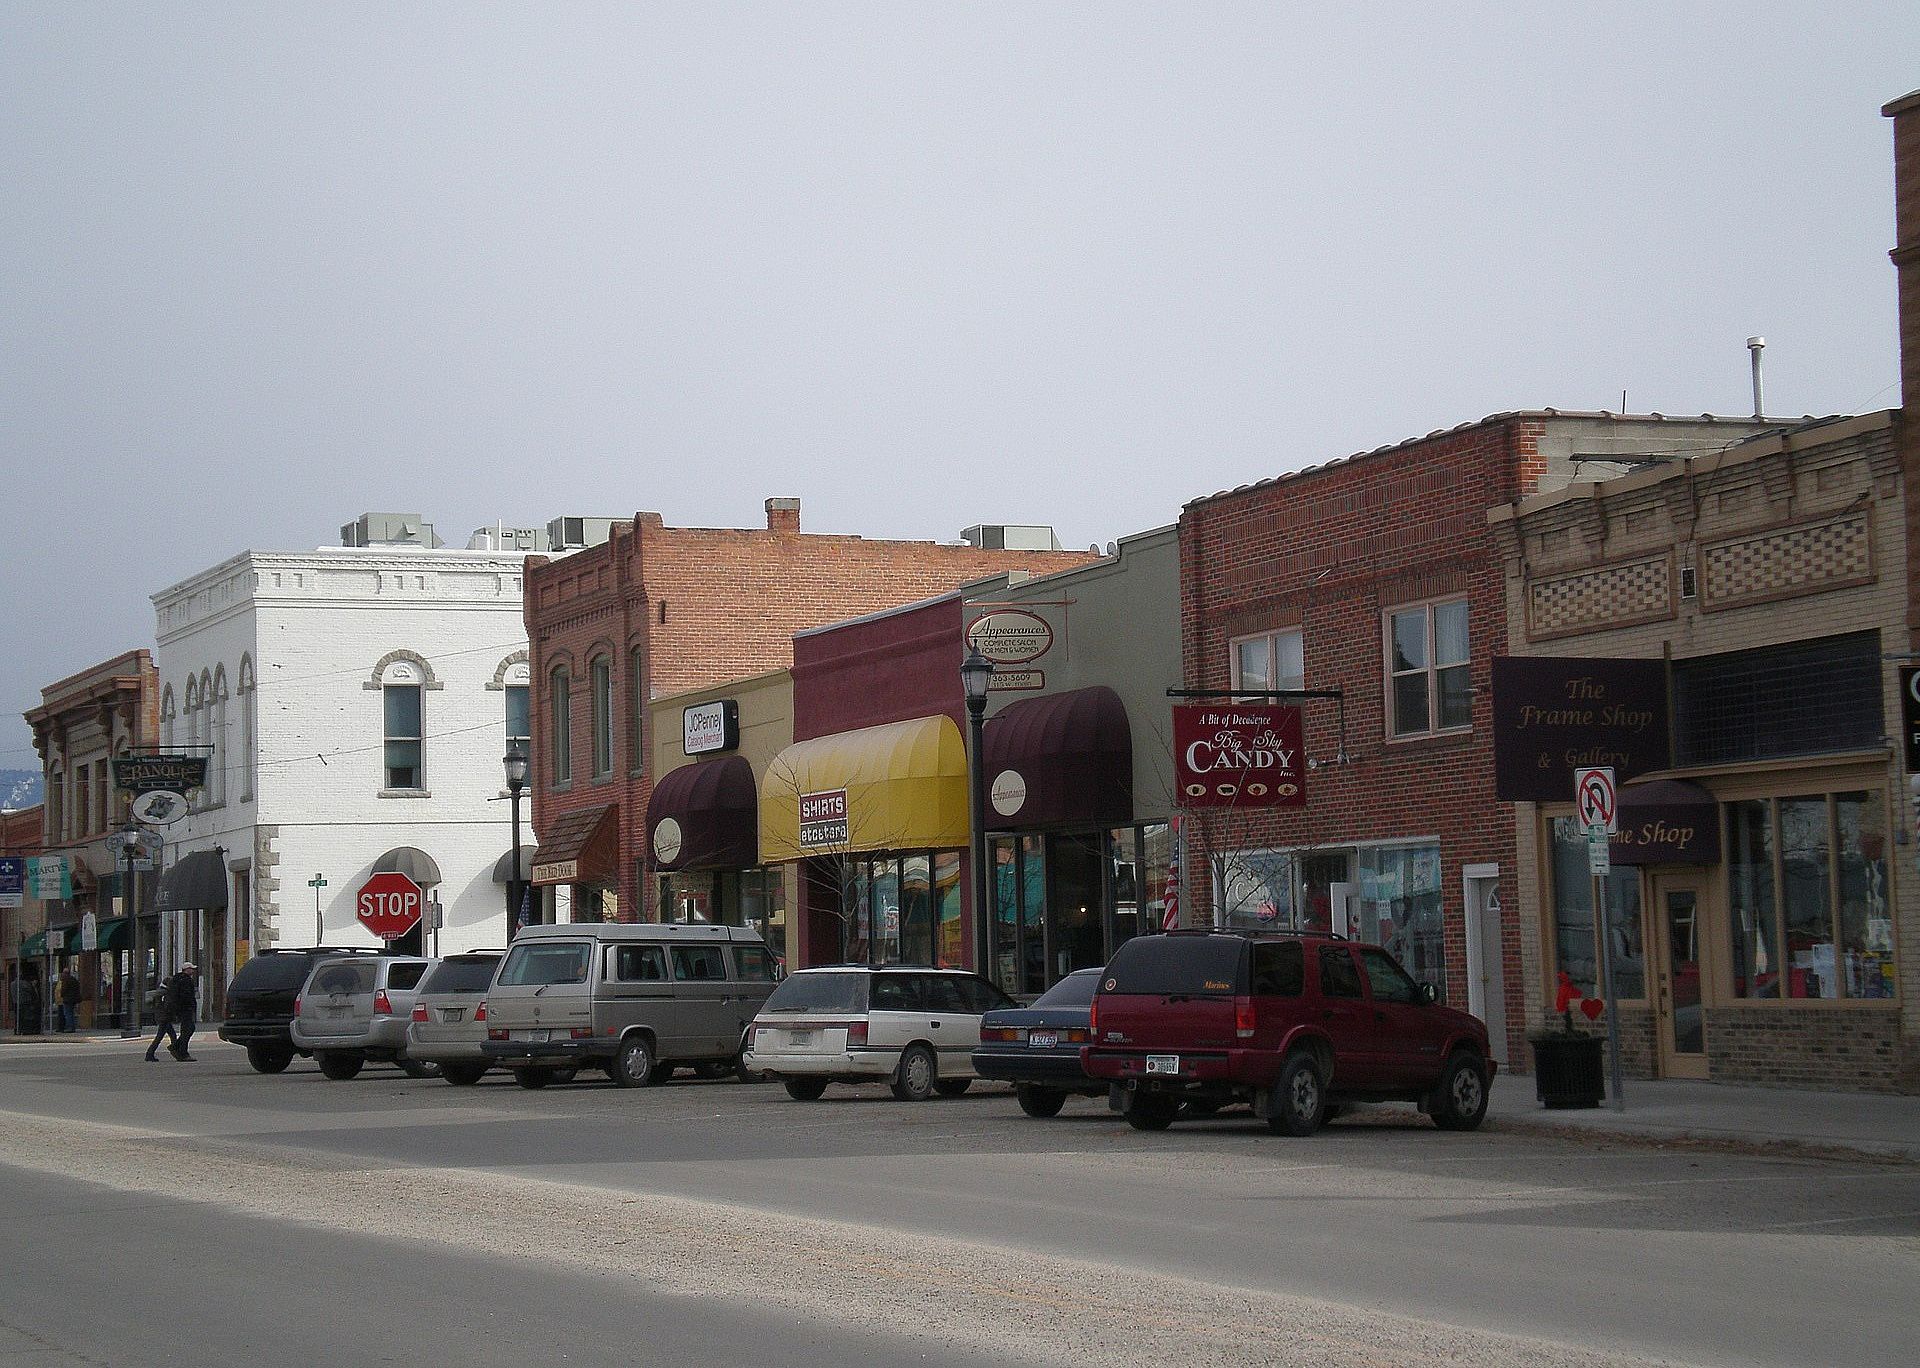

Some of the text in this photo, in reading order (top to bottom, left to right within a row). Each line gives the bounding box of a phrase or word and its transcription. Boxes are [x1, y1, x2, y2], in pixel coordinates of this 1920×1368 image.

[973, 618, 1046, 639] Appearances
[1565, 676, 1605, 700] The
[688, 713, 722, 733] JCPenney
[1198, 713, 1271, 728] A Bit of Decadence
[1516, 703, 1653, 733] Frame Shop
[1211, 729, 1284, 753] Big Sky
[1186, 740, 1295, 773] CANDY
[1537, 746, 1630, 769] & Gallery
[802, 796, 844, 818] SHIRTS
[801, 825, 847, 842] etcetera
[1637, 820, 1694, 850] Shop
[360, 892, 418, 917] STOP
